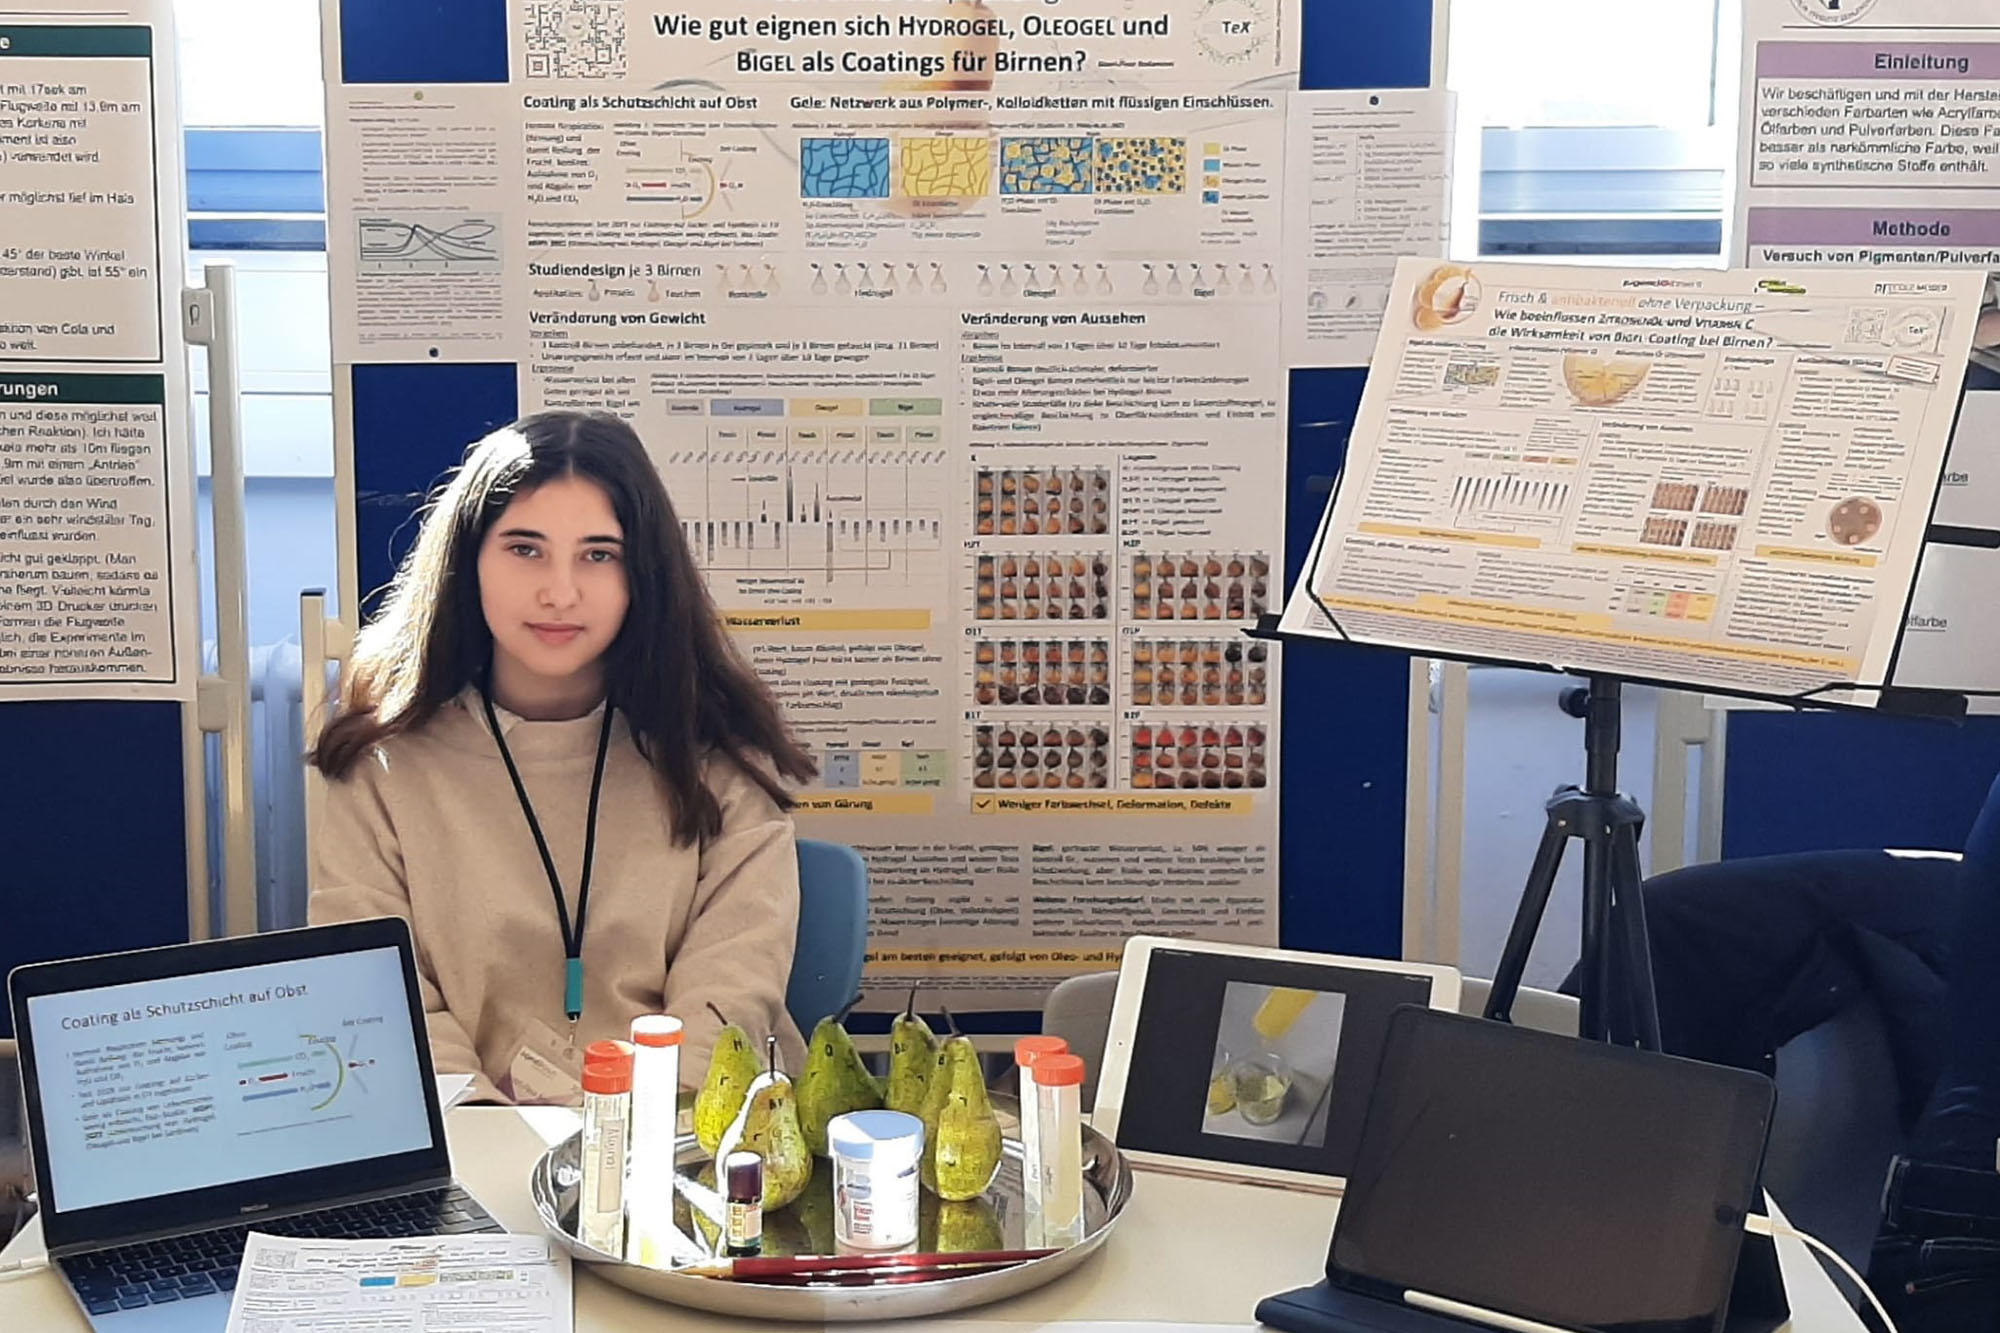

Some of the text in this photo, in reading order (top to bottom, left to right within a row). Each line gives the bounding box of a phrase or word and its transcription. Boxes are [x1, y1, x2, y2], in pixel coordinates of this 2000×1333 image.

[655, 15, 701, 36] Wie
[710, 16, 747, 40] gut
[757, 15, 836, 40] eignen
[845, 15, 889, 36] sich
[1023, 16, 1115, 36] OLEOGEL
[1124, 15, 1168, 35] und
[1222, 21, 1251, 34] TeX
[738, 51, 795, 71] BIGEL
[803, 51, 834, 71] als
[842, 52, 944, 77] Coatings
[953, 51, 987, 71] für
[995, 50, 1086, 71] Birnen?
[1875, 54, 1968, 72] Einleitung
[524, 95, 757, 109] Coating als Schutzschicht auf Obst
[900, 97, 923, 108] aus
[1092, 96, 1114, 108] mit
[1762, 89, 1784, 100] Wir
[1789, 88, 1871, 103] beschäftigen
[1876, 90, 1899, 101] und
[1904, 90, 1923, 101] mit
[1927, 90, 1949, 101] der
[1762, 107, 1839, 118] verschieden
[1844, 107, 1907, 118] Farbarten
[1912, 108, 1933, 118] wie
[1761, 122, 1816, 135] Ölfarben
[1821, 124, 1844, 135] und
[1849, 124, 1934, 136] Pulverfarben.
[1940, 125, 1979, 136] Diese
[1760, 142, 1803, 153] besser
[1808, 142, 1826, 153] als
[1925, 142, 1968, 155] Farbe,
[1973, 143, 1999, 154] weil
[1759, 160, 1775, 170] so
[1779, 159, 1807, 171] viele
[1898, 160, 1935, 171] Stoffe
[1940, 160, 1987, 172] enthält.
[1873, 221, 1950, 236] Methode
[1764, 250, 1822, 262] Versuch
[1828, 251, 1854, 262] von
[529, 264, 624, 277] Studiendesign
[645, 265, 652, 275] 3
[657, 265, 701, 276] Birnen
[530, 312, 705, 326] Veränderung von Gewicht
[961, 313, 1145, 326] Veränderung von Aussehen
[86, 499, 117, 509] Wind
[998, 799, 1041, 811] Weniger
[1029, 953, 1048, 961] von
[1083, 951, 1103, 960] und
[62, 1011, 119, 1030] Coating
[147, 994, 243, 1017] Schutzschicht
[249, 988, 271, 1003] auf
[275, 985, 307, 999] Obst
